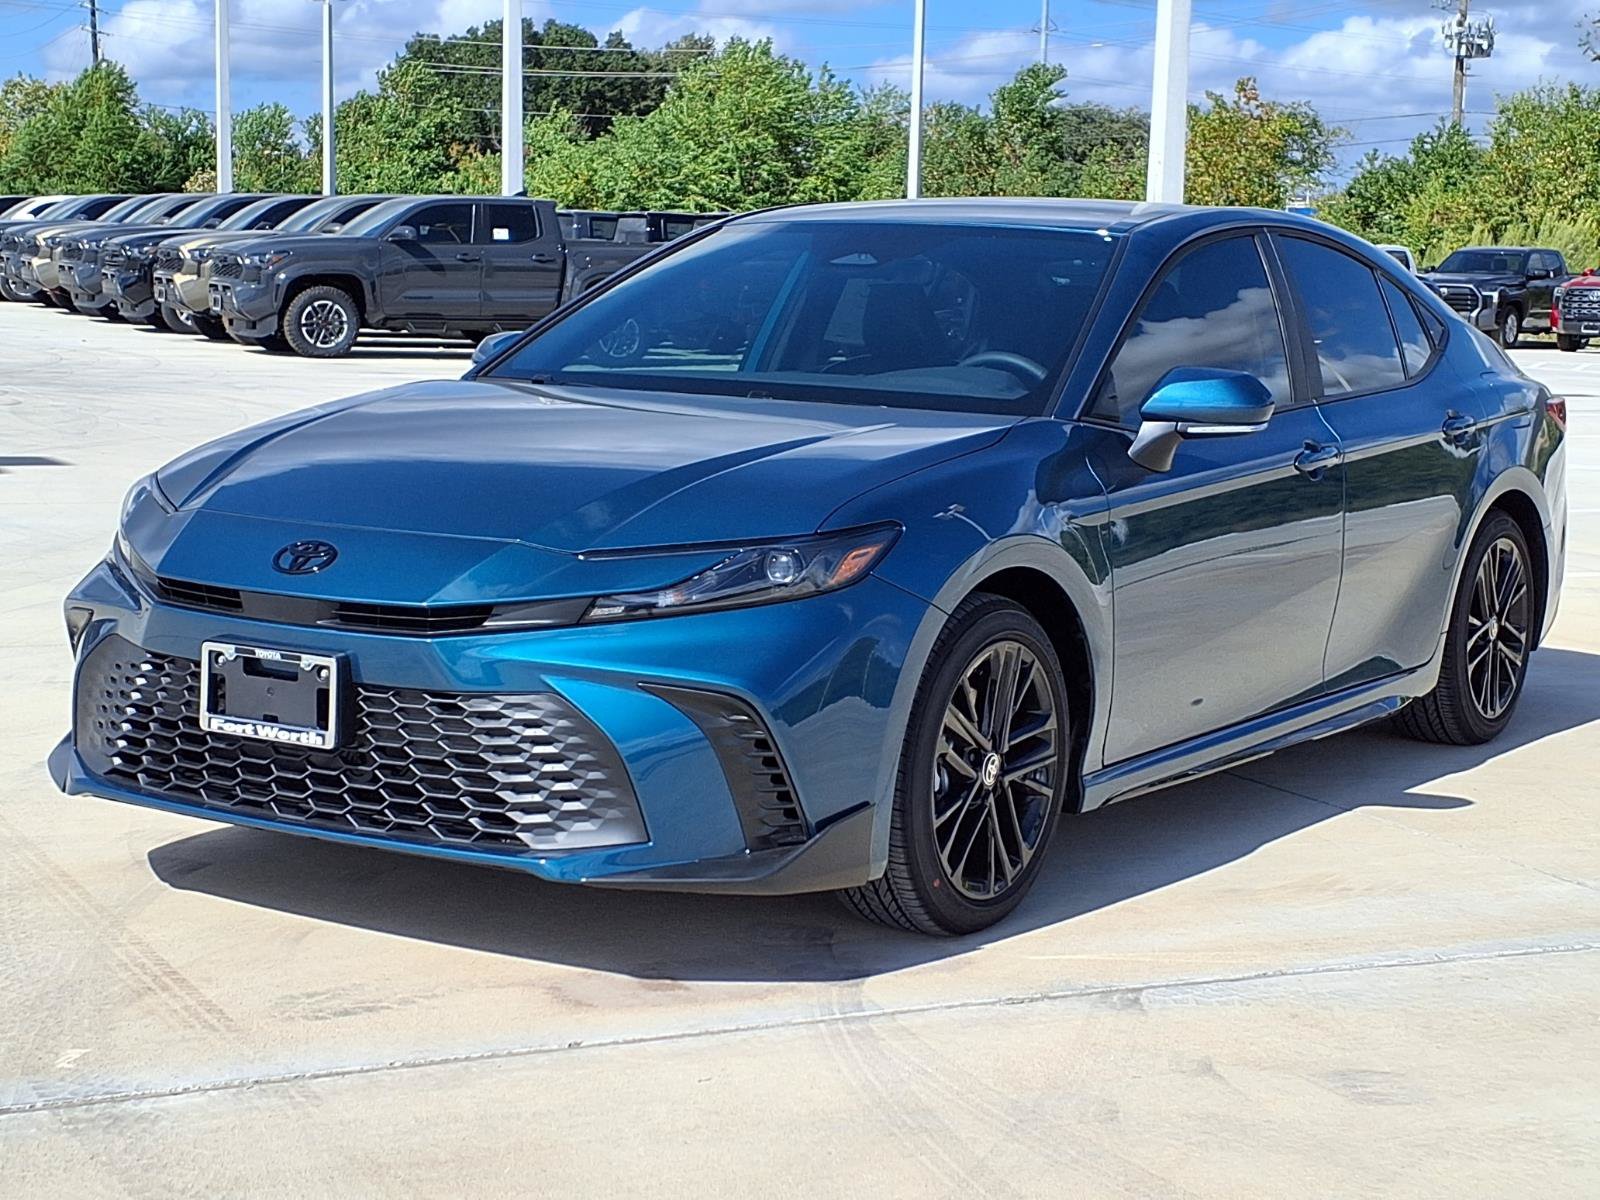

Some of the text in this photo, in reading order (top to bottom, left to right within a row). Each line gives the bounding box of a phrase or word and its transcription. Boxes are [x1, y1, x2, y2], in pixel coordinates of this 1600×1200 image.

[254, 649, 282, 661] TOYOTA
[210, 718, 323, 745] Fort Worth
